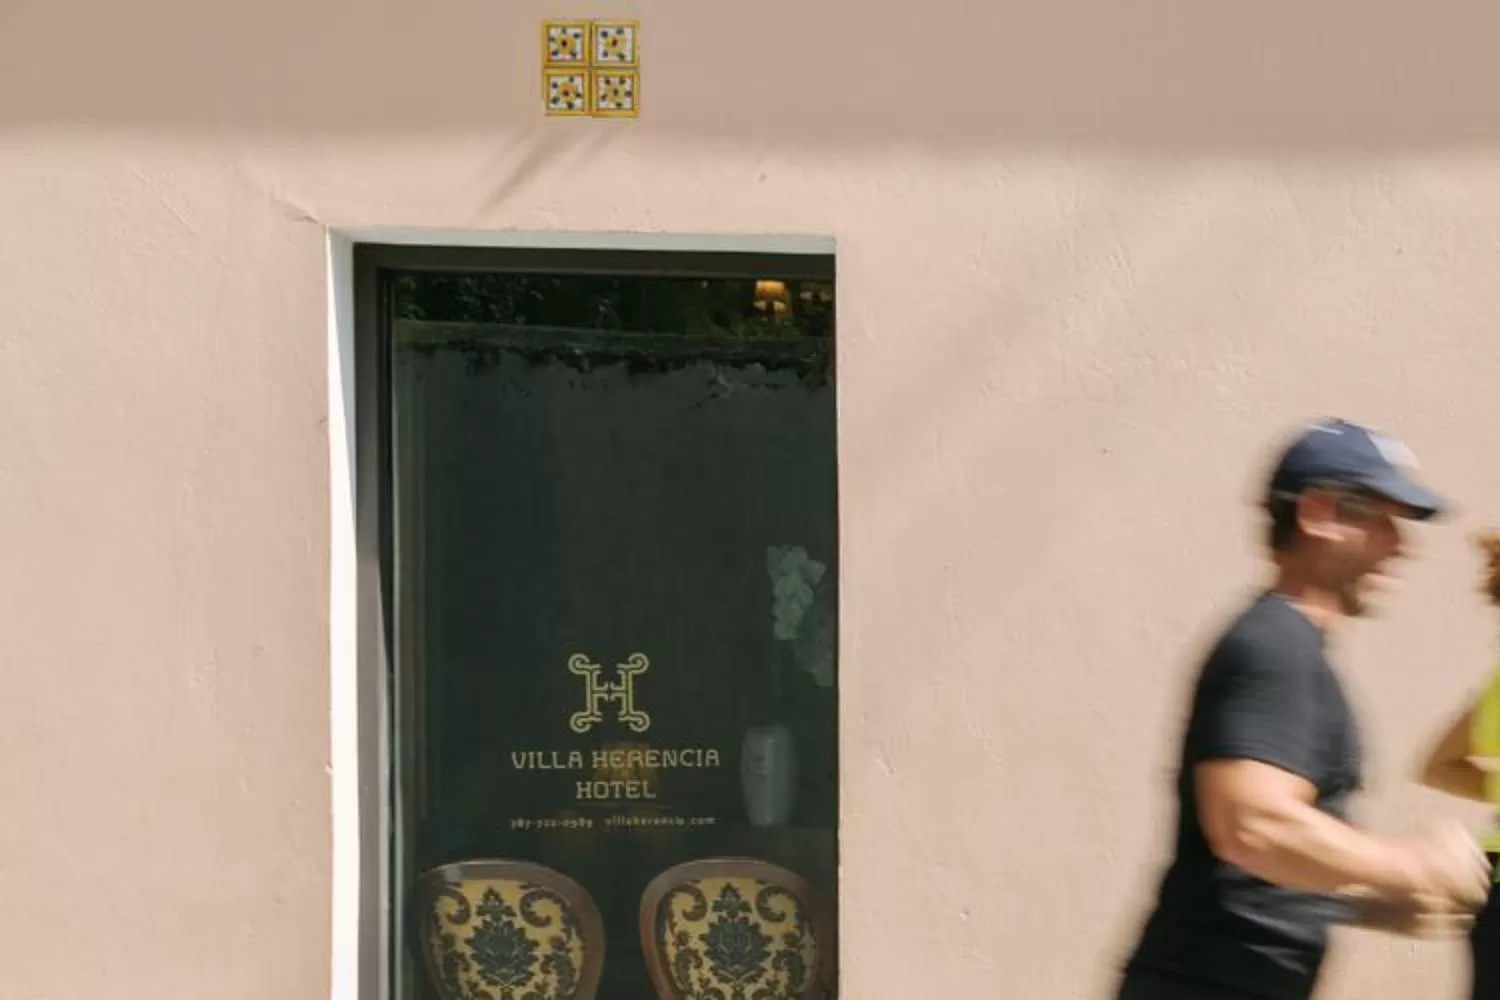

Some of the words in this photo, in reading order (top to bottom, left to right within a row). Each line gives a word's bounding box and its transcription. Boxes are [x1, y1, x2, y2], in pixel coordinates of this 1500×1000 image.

[511, 751, 583, 769] VILLA
[591, 749, 721, 768] HERENCIA
[576, 781, 657, 799] HOTEL
